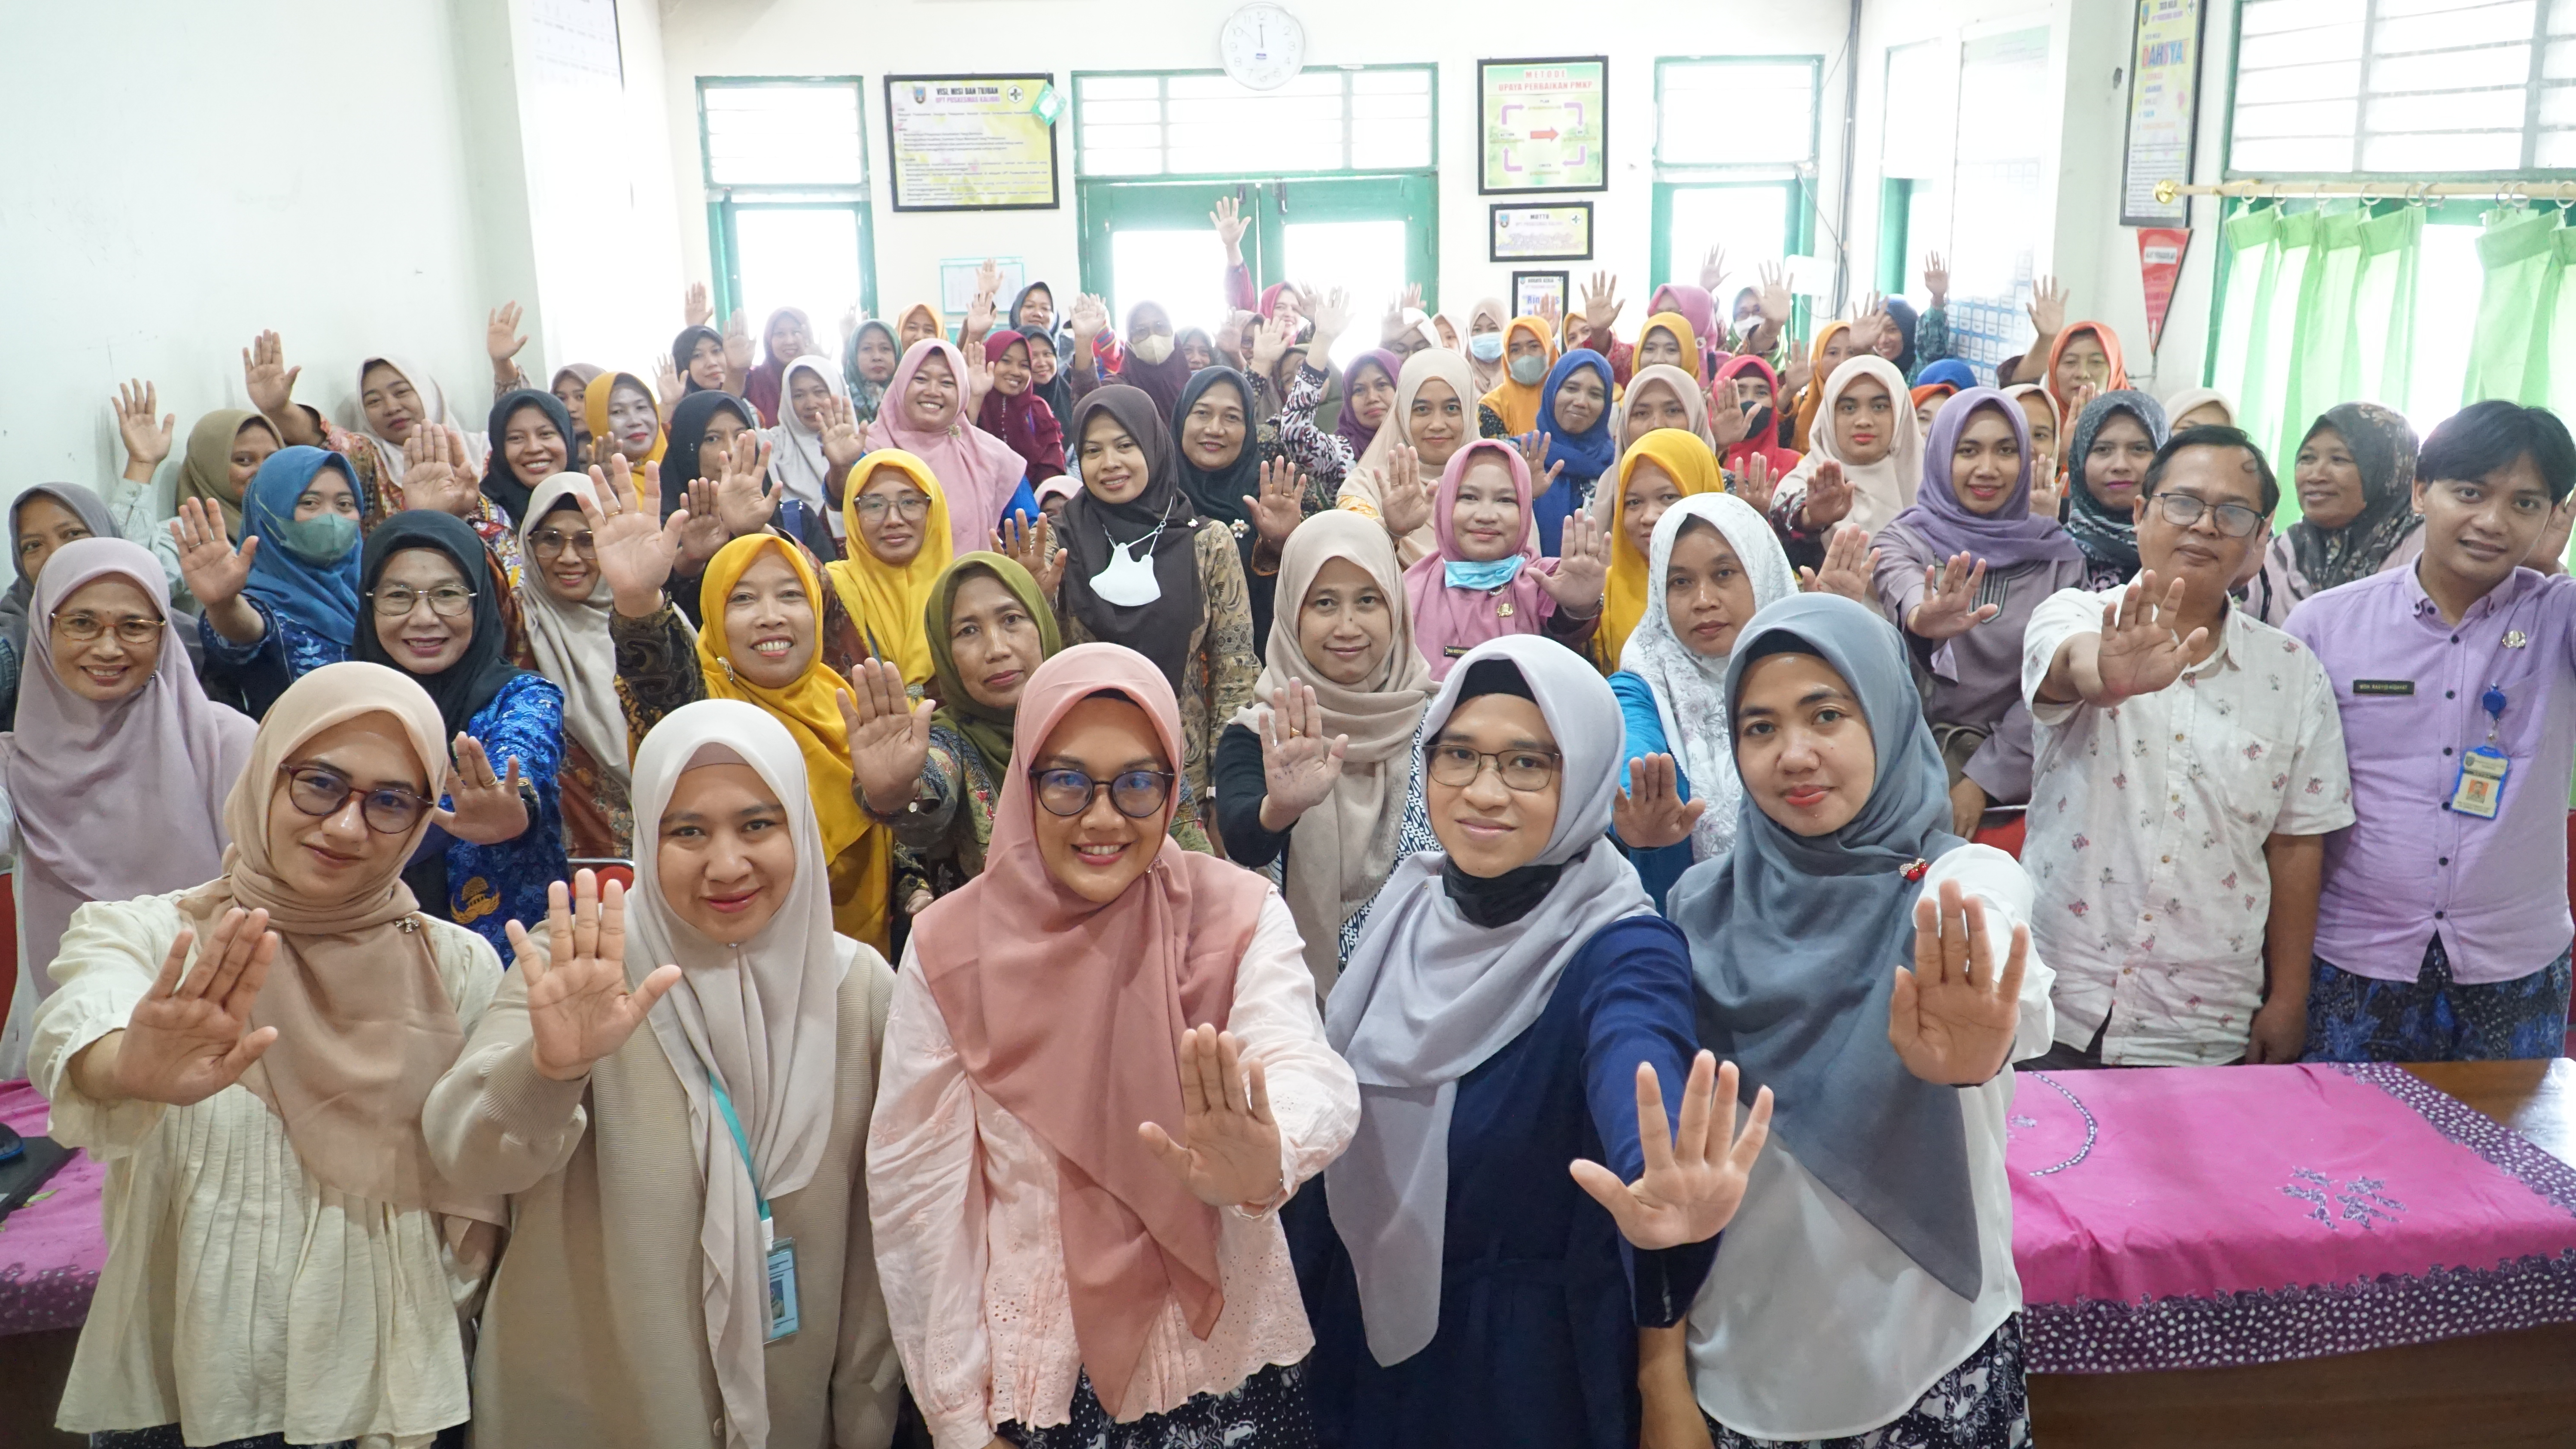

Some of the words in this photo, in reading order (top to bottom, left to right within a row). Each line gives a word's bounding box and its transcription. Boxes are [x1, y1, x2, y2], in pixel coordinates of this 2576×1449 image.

[1257, 11, 1267, 20] 12
[1233, 27, 1243, 37] 10
[1283, 26, 1291, 35] 2
[1230, 42, 1237, 52] 9
[1288, 41, 1296, 51] 3
[1235, 57, 1242, 67] 8
[1245, 69, 1254, 78] 7
[1273, 68, 1281, 77] 5
[1525, 70, 1565, 79] METODE
[1525, 82, 1568, 91] PERBAIKAN
